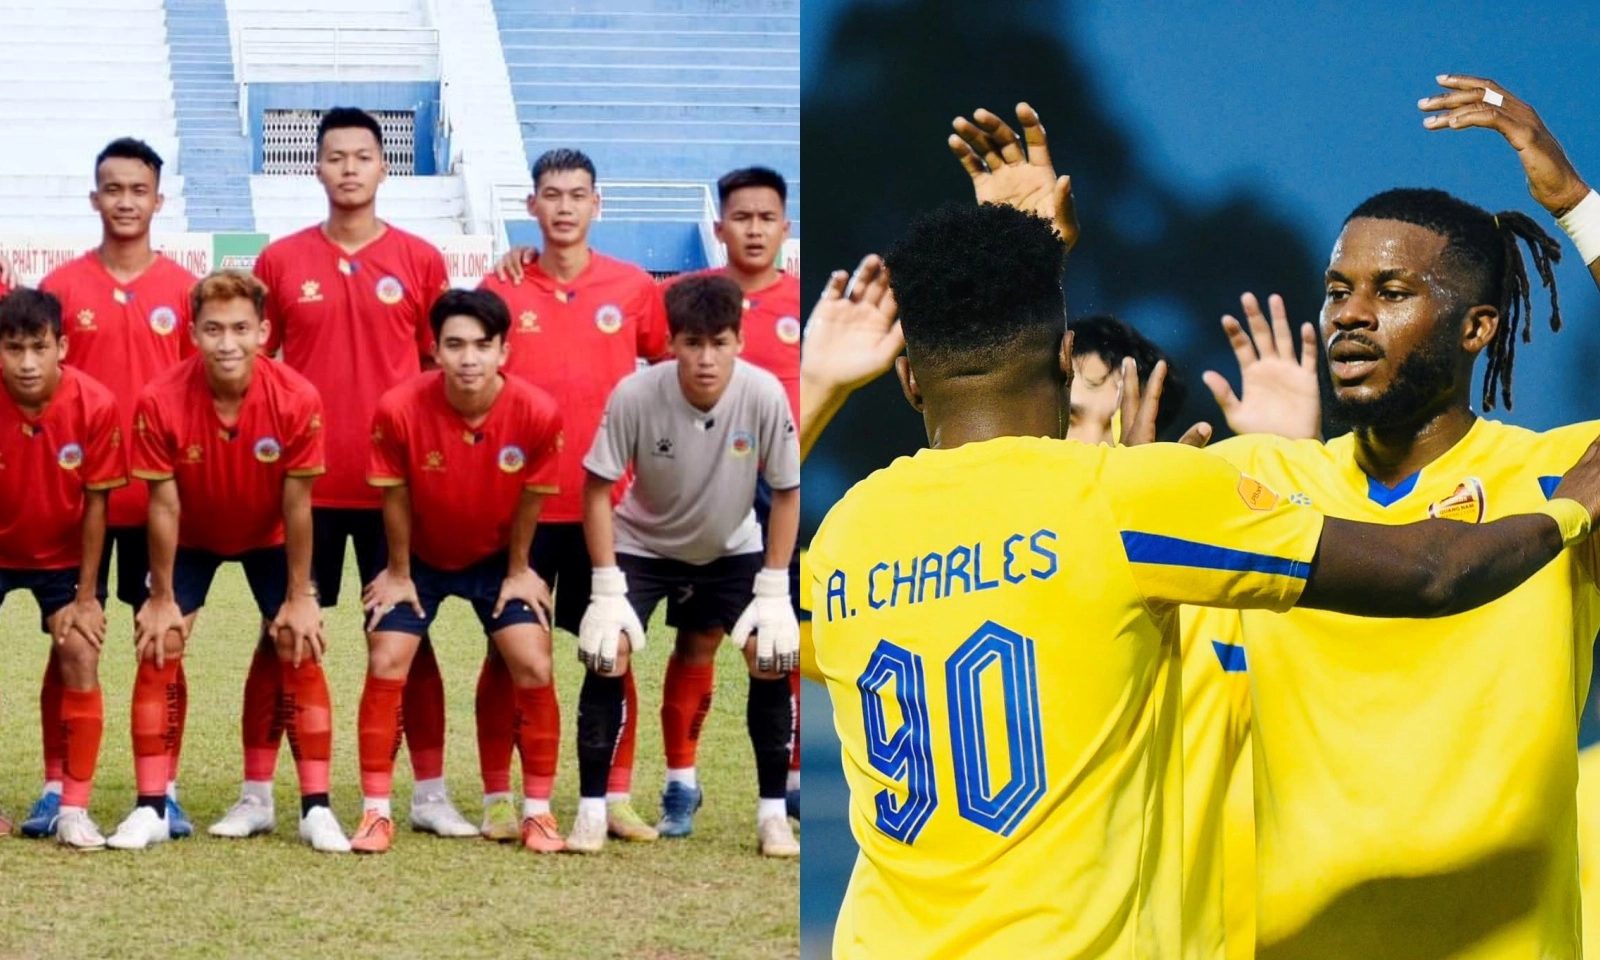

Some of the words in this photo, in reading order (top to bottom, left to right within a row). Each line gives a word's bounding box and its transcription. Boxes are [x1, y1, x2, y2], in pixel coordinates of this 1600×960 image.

[462, 252, 488, 278] LONG
[827, 569, 856, 622] A.
[868, 528, 1058, 610] CHARLES
[856, 620, 1048, 846] 90
